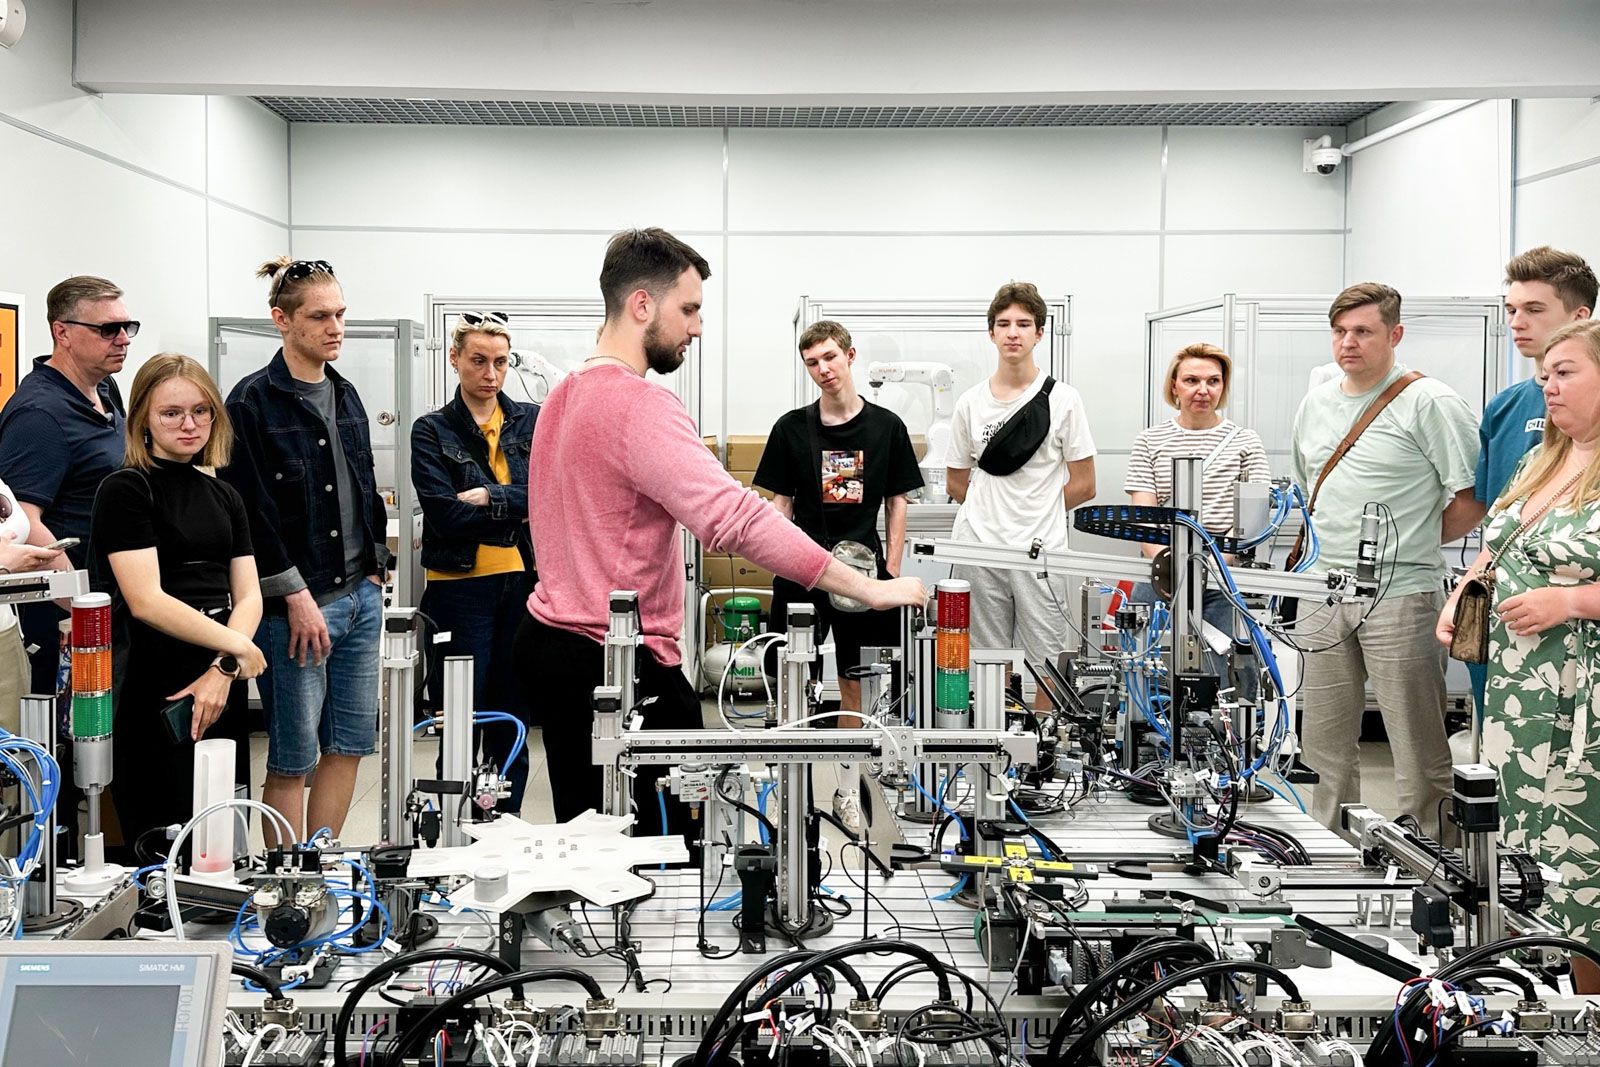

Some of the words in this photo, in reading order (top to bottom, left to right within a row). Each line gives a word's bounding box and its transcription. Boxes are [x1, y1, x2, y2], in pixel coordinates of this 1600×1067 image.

[20, 964, 50, 972] SIEMENS
[139, 963, 169, 972] SIMATIC
[170, 964, 186, 972] HMI
[175, 986, 194, 1031] TOUCH
